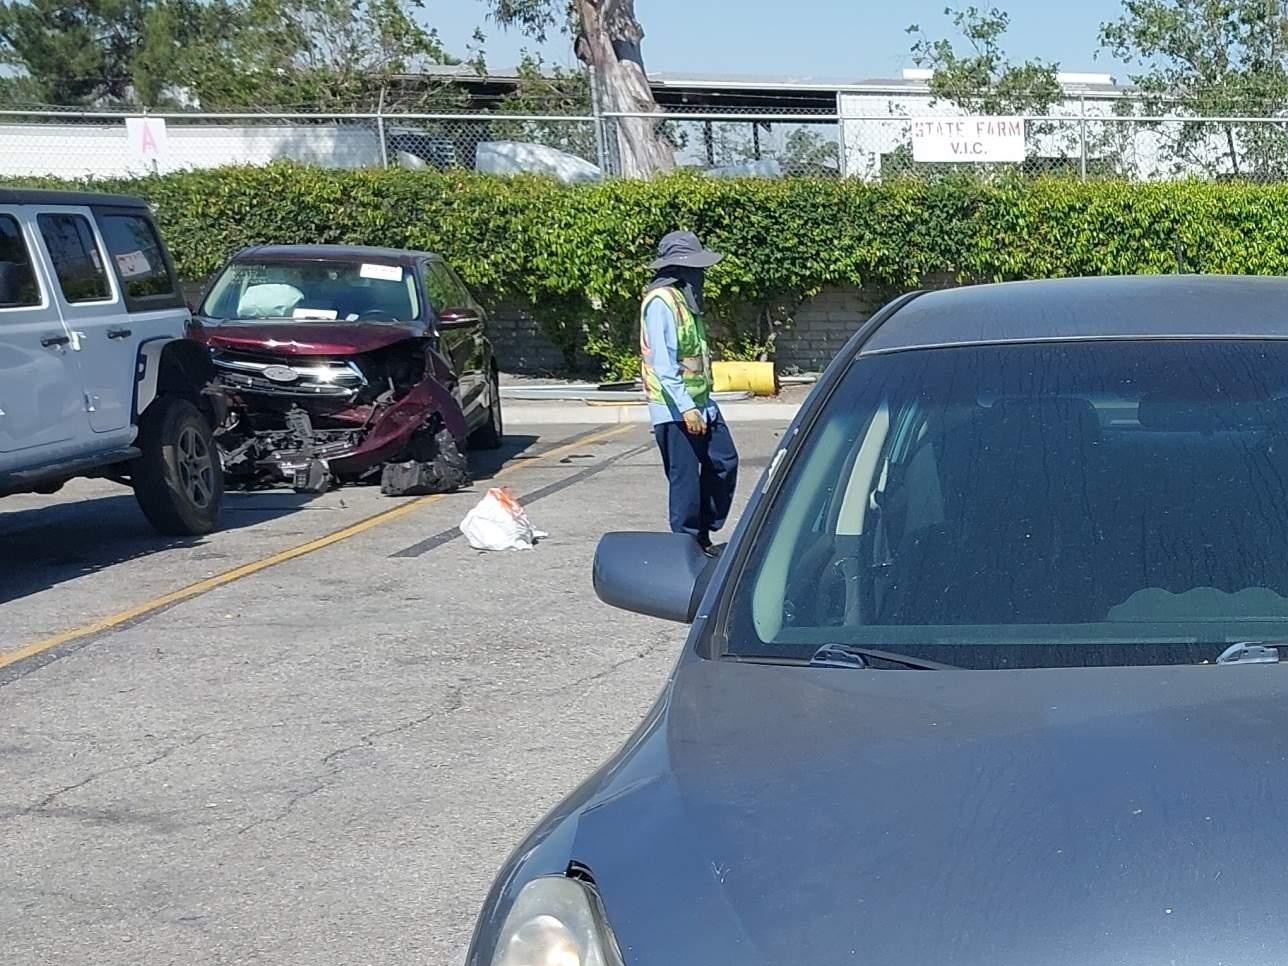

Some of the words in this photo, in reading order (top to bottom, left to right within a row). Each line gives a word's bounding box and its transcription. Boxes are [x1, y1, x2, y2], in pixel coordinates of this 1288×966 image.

[915, 121, 965, 137] STATE
[976, 121, 1021, 137] FARM
[142, 121, 159, 155] A
[951, 142, 988, 155] V.I.C.
